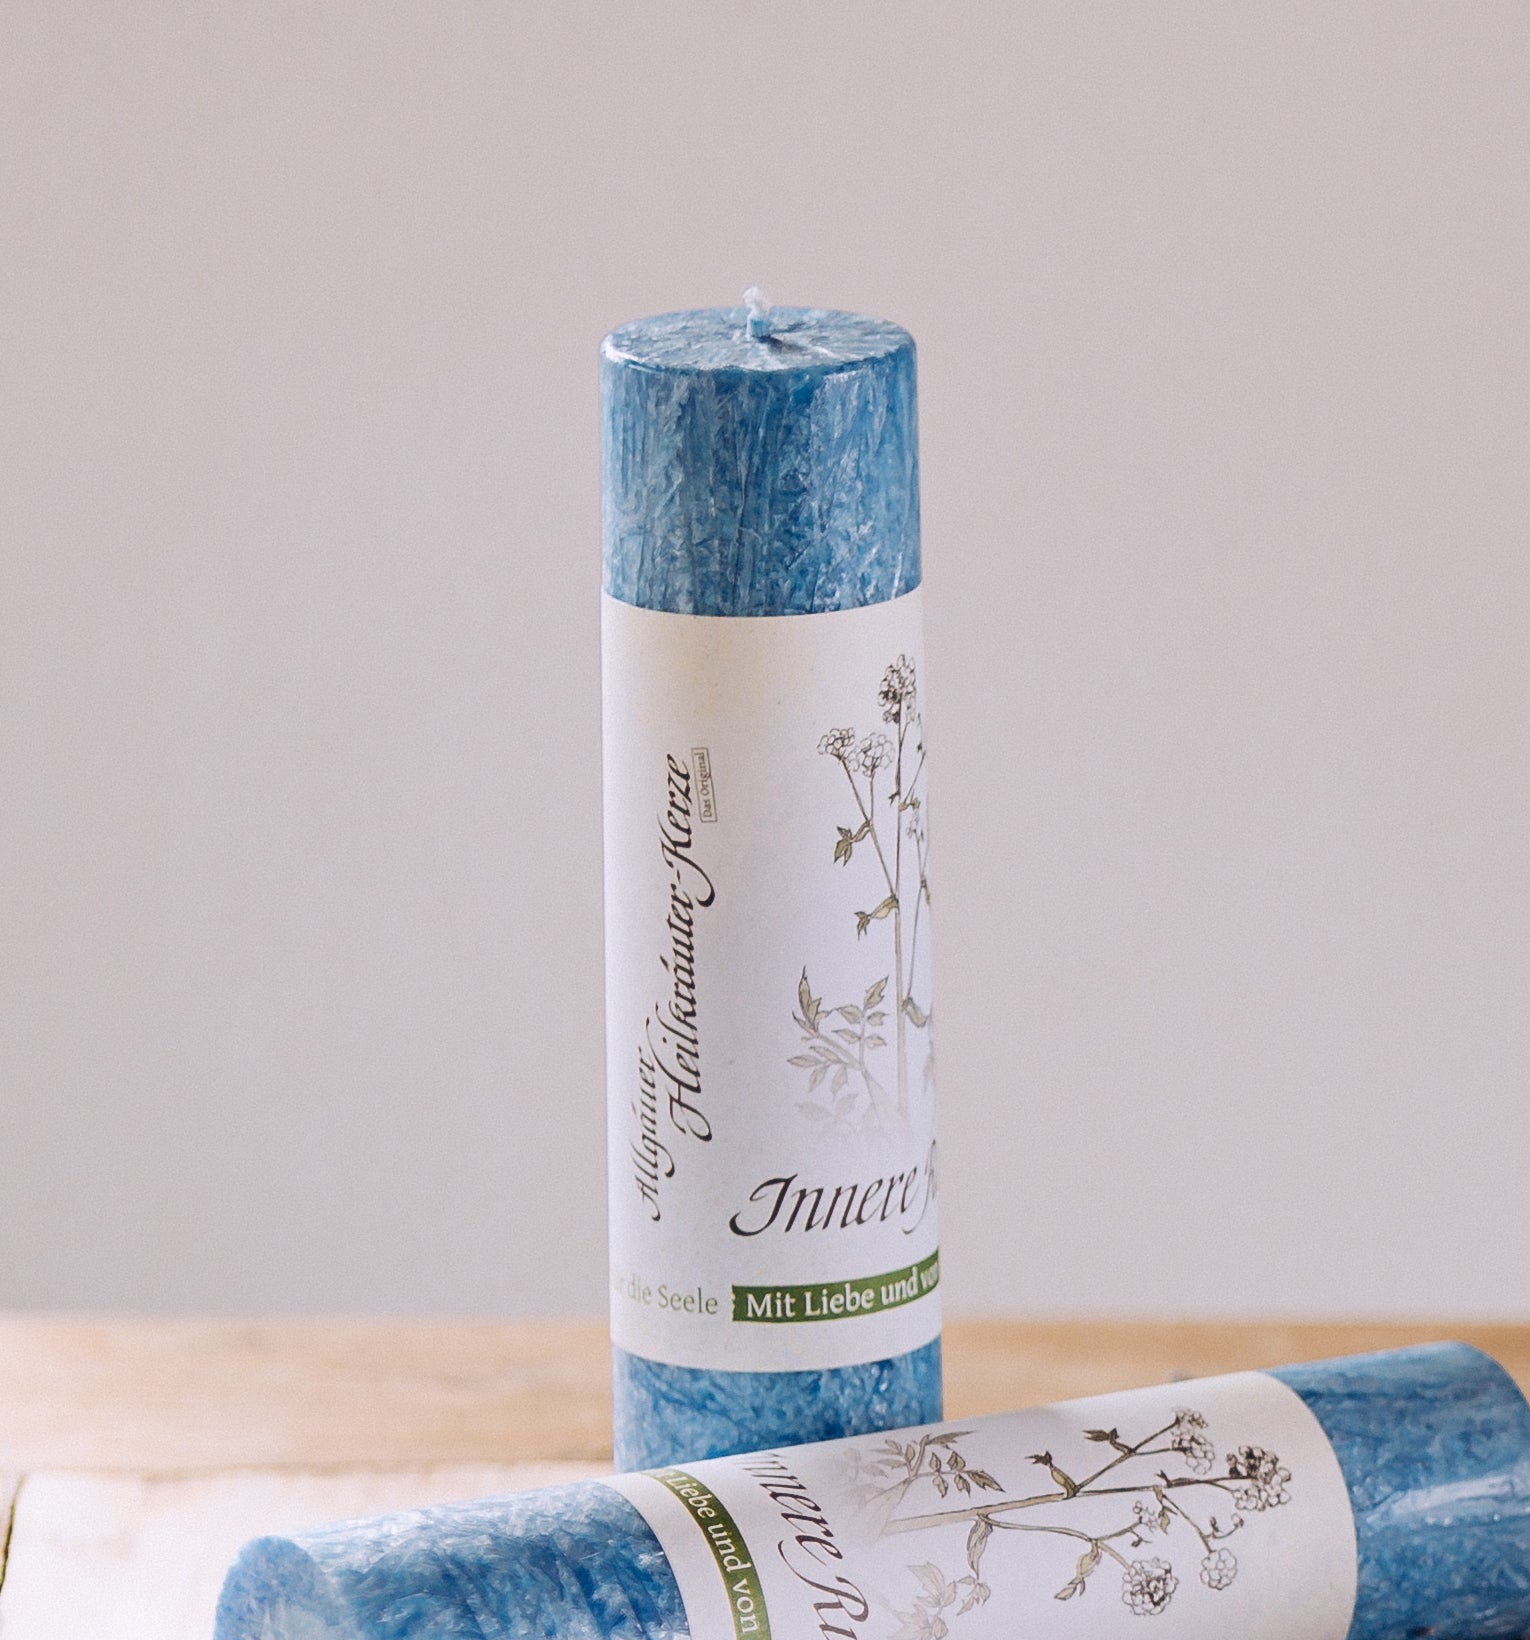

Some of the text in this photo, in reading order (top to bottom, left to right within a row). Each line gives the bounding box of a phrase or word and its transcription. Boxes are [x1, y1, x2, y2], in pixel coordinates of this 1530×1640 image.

[694, 752, 713, 818] Das Original
[729, 1166, 918, 1236] Innere
[657, 1283, 719, 1315] Seele
[746, 1293, 796, 1318] Mit
[804, 1284, 875, 1317] Liebe
[881, 1266, 919, 1304] und
[665, 1476, 715, 1518] Liebe
[707, 1523, 752, 1573] und
[732, 1578, 758, 1633] von
